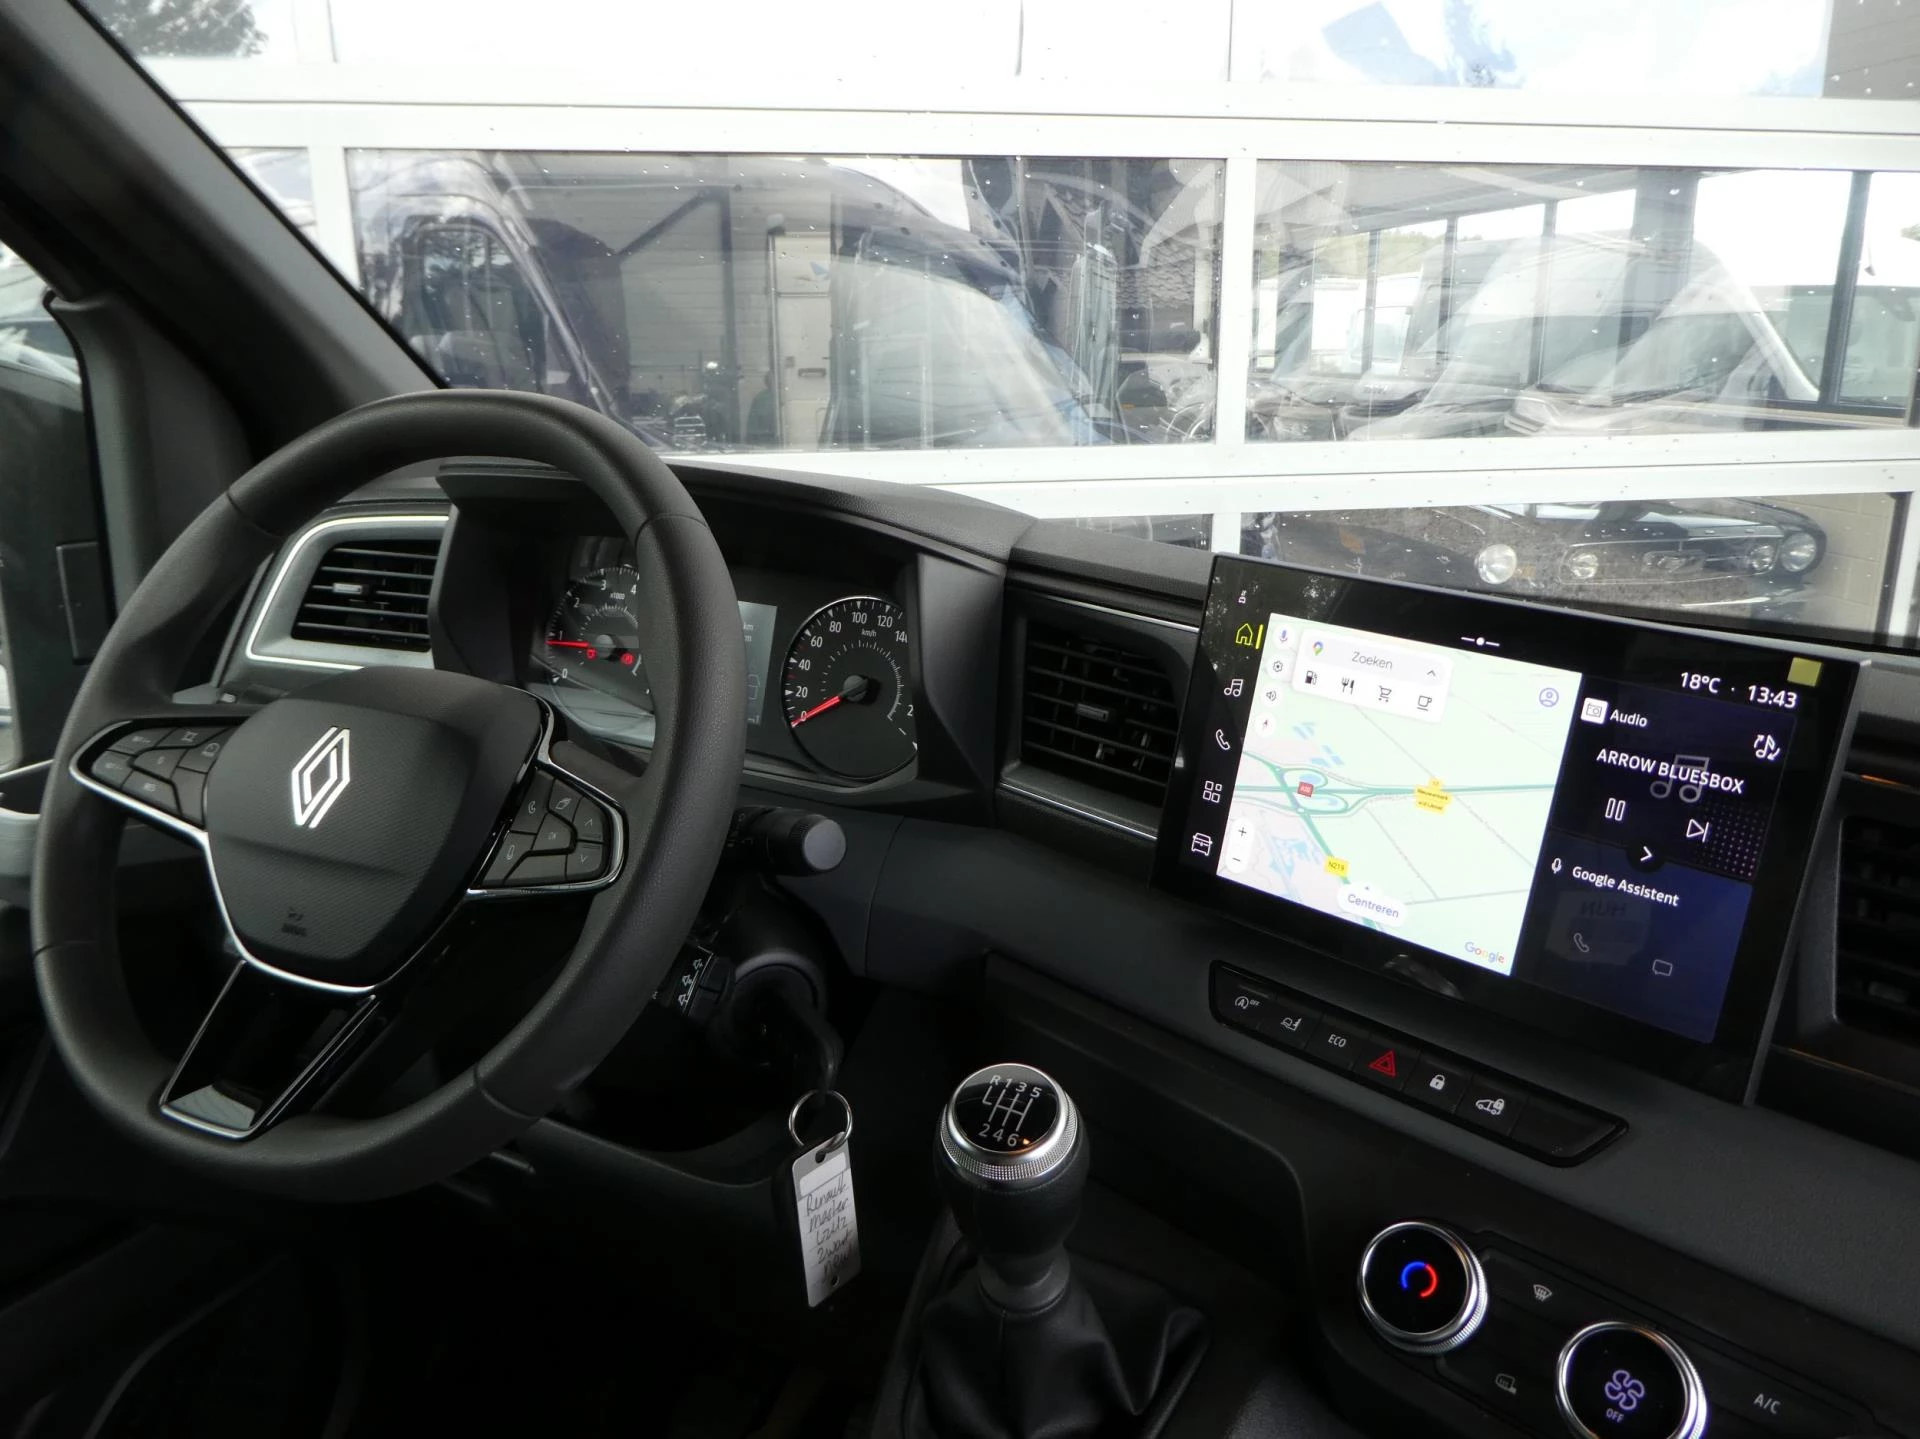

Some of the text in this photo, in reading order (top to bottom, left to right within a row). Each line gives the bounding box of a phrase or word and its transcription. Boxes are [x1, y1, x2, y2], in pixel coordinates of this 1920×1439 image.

[601, 580, 607, 591] 3
[630, 584, 637, 595] 4
[852, 612, 868, 624] 100
[877, 616, 893, 628] 120
[829, 621, 842, 633] 80
[861, 628, 877, 637] km/h
[810, 636, 823, 648] 60
[798, 659, 811, 671] 40
[1351, 650, 1393, 670] Zoeken
[562, 668, 568, 679] 0
[795, 686, 808, 698] 20
[1747, 684, 1798, 709] 13:43
[800, 711, 807, 721] 0
[1610, 709, 1648, 728] Audio
[1596, 747, 1745, 795] ARROW BLUESBOX
[1327, 859, 1346, 872] N219
[1572, 865, 1680, 907] Google Assistent
[1347, 892, 1400, 918] Centreren
[1464, 940, 1505, 964] Google
[1327, 1033, 1347, 1049] ECO
[989, 1075, 1042, 1098] R 1 3 5
[978, 1123, 1019, 1147] 2 4 6
[1753, 1392, 1780, 1415] A/C
[1606, 1407, 1625, 1423] OFF
